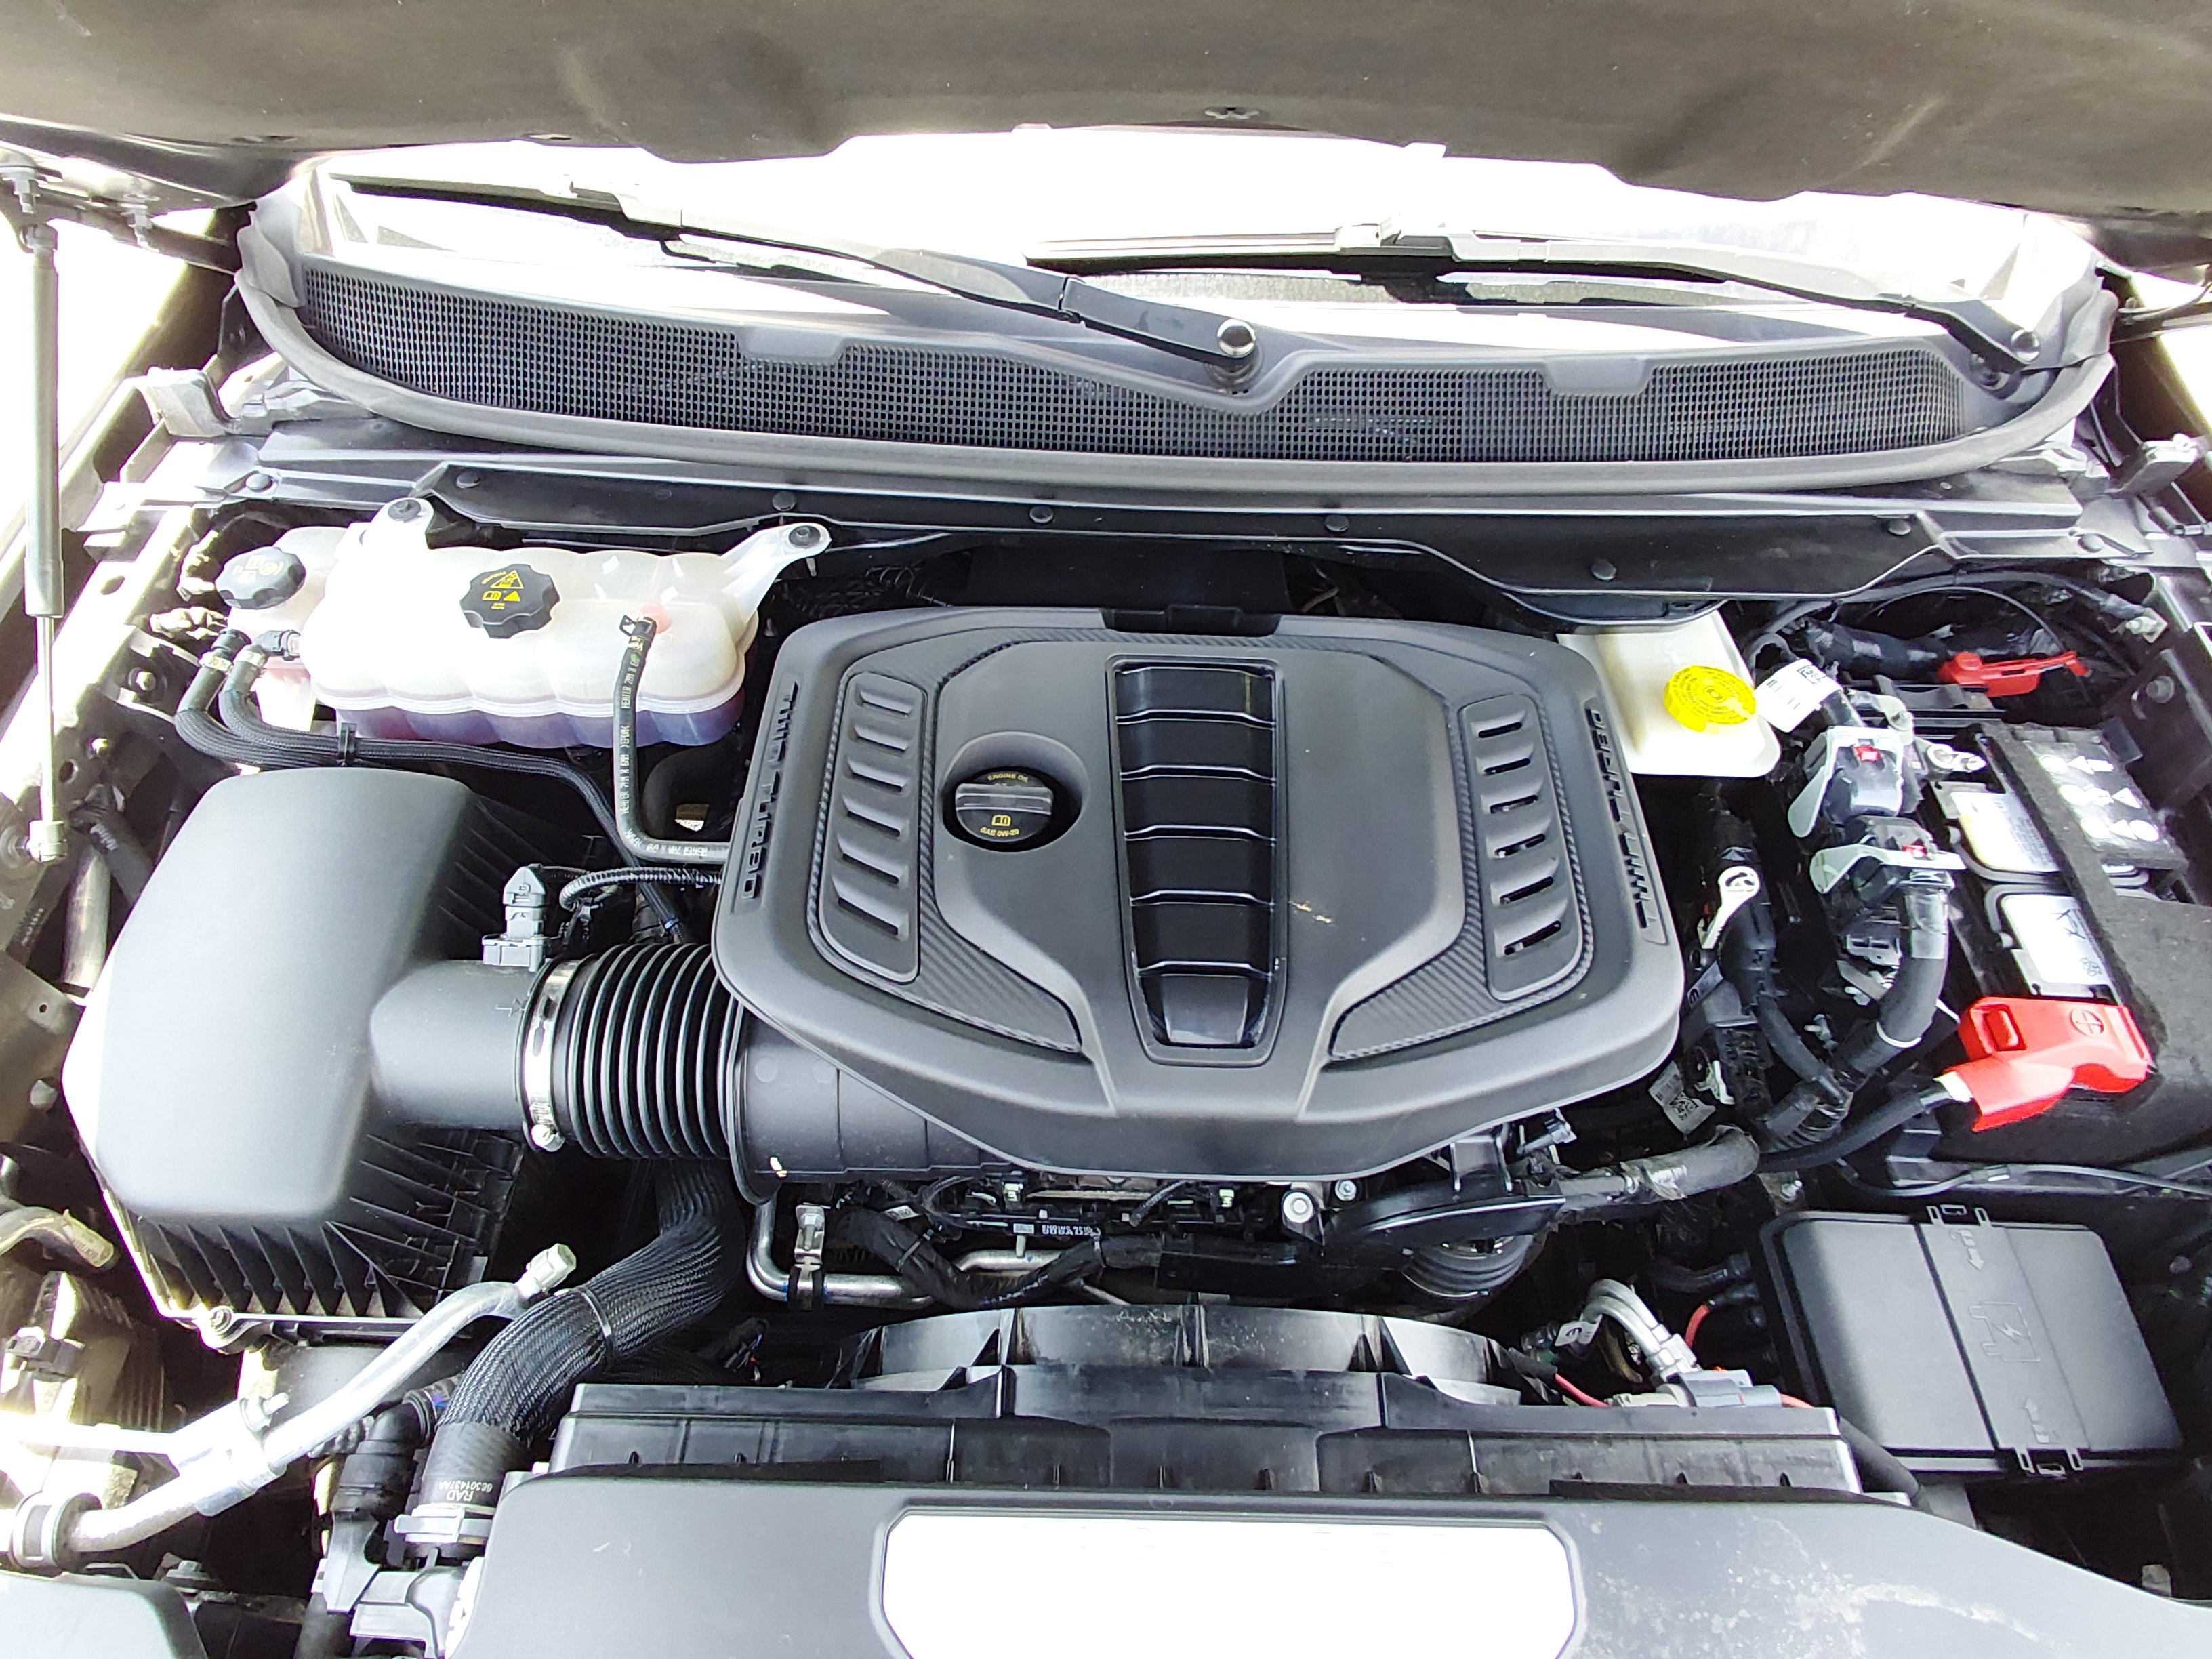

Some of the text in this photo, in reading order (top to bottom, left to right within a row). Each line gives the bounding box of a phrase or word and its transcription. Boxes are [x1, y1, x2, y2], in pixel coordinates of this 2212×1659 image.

[621, 686, 632, 709] HEATER
[987, 773, 1029, 783] ENGINE OIL
[741, 680, 800, 900] TWIN TURBO
[620, 790, 630, 814] HEATER
[1584, 708, 1658, 929] TWIN TURBO
[980, 827, 1020, 837] SAE 0W-20
[446, 1489, 474, 1502] RAD
